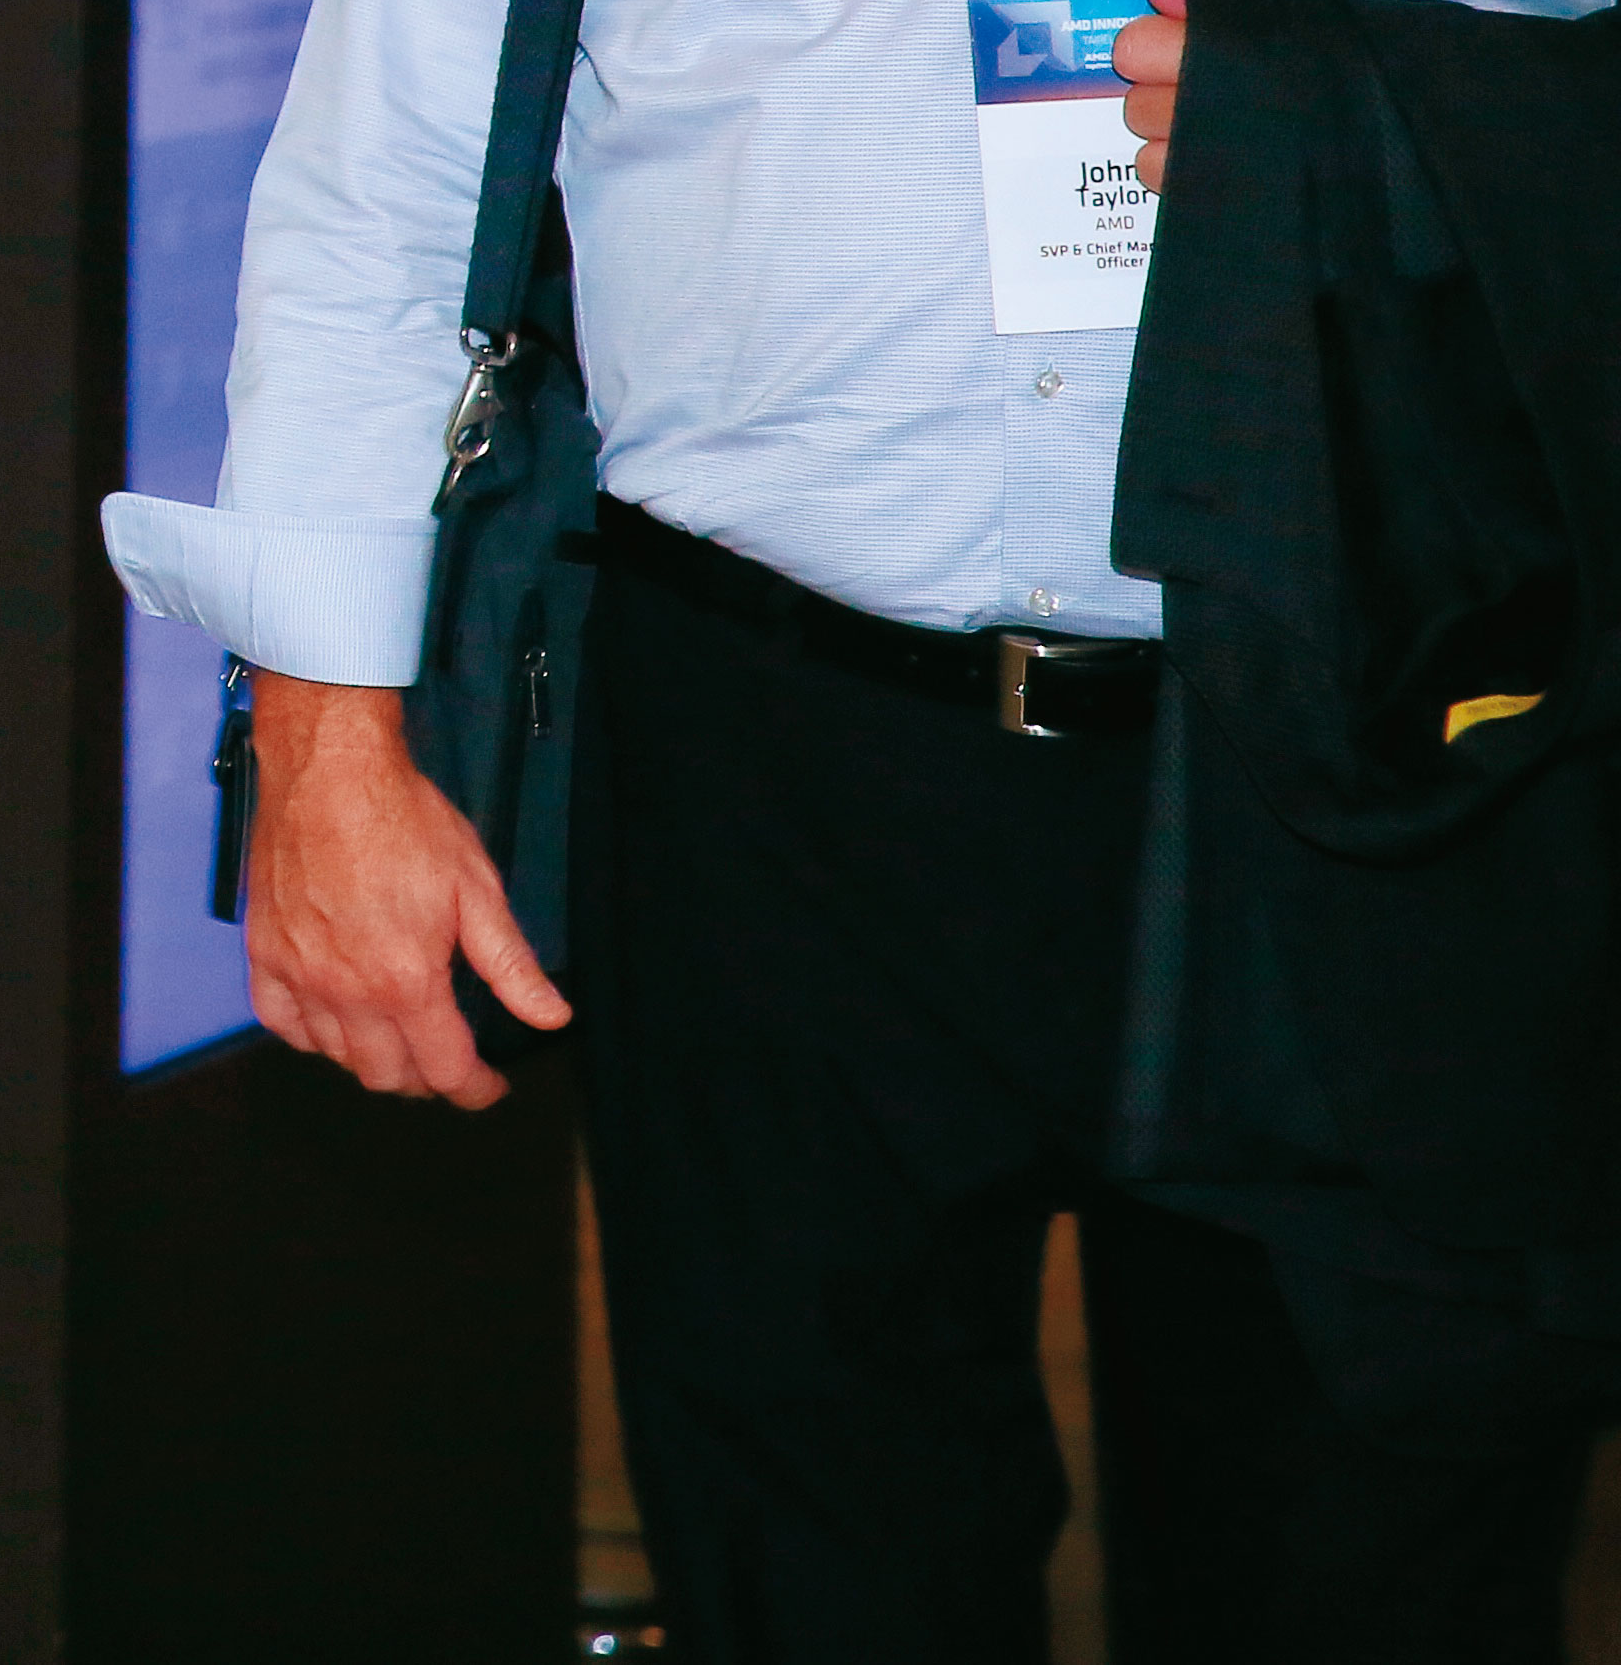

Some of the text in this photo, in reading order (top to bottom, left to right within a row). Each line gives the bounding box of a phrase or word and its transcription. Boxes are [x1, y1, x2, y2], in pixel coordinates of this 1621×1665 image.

[1061, 19, 1091, 31] AMD
[1074, 185, 1149, 211] Taylor
[1095, 215, 1135, 231] AMD
[1040, 245, 1069, 258] SVP
[1086, 241, 1123, 255] Chief
[1096, 256, 1145, 269] Officer
